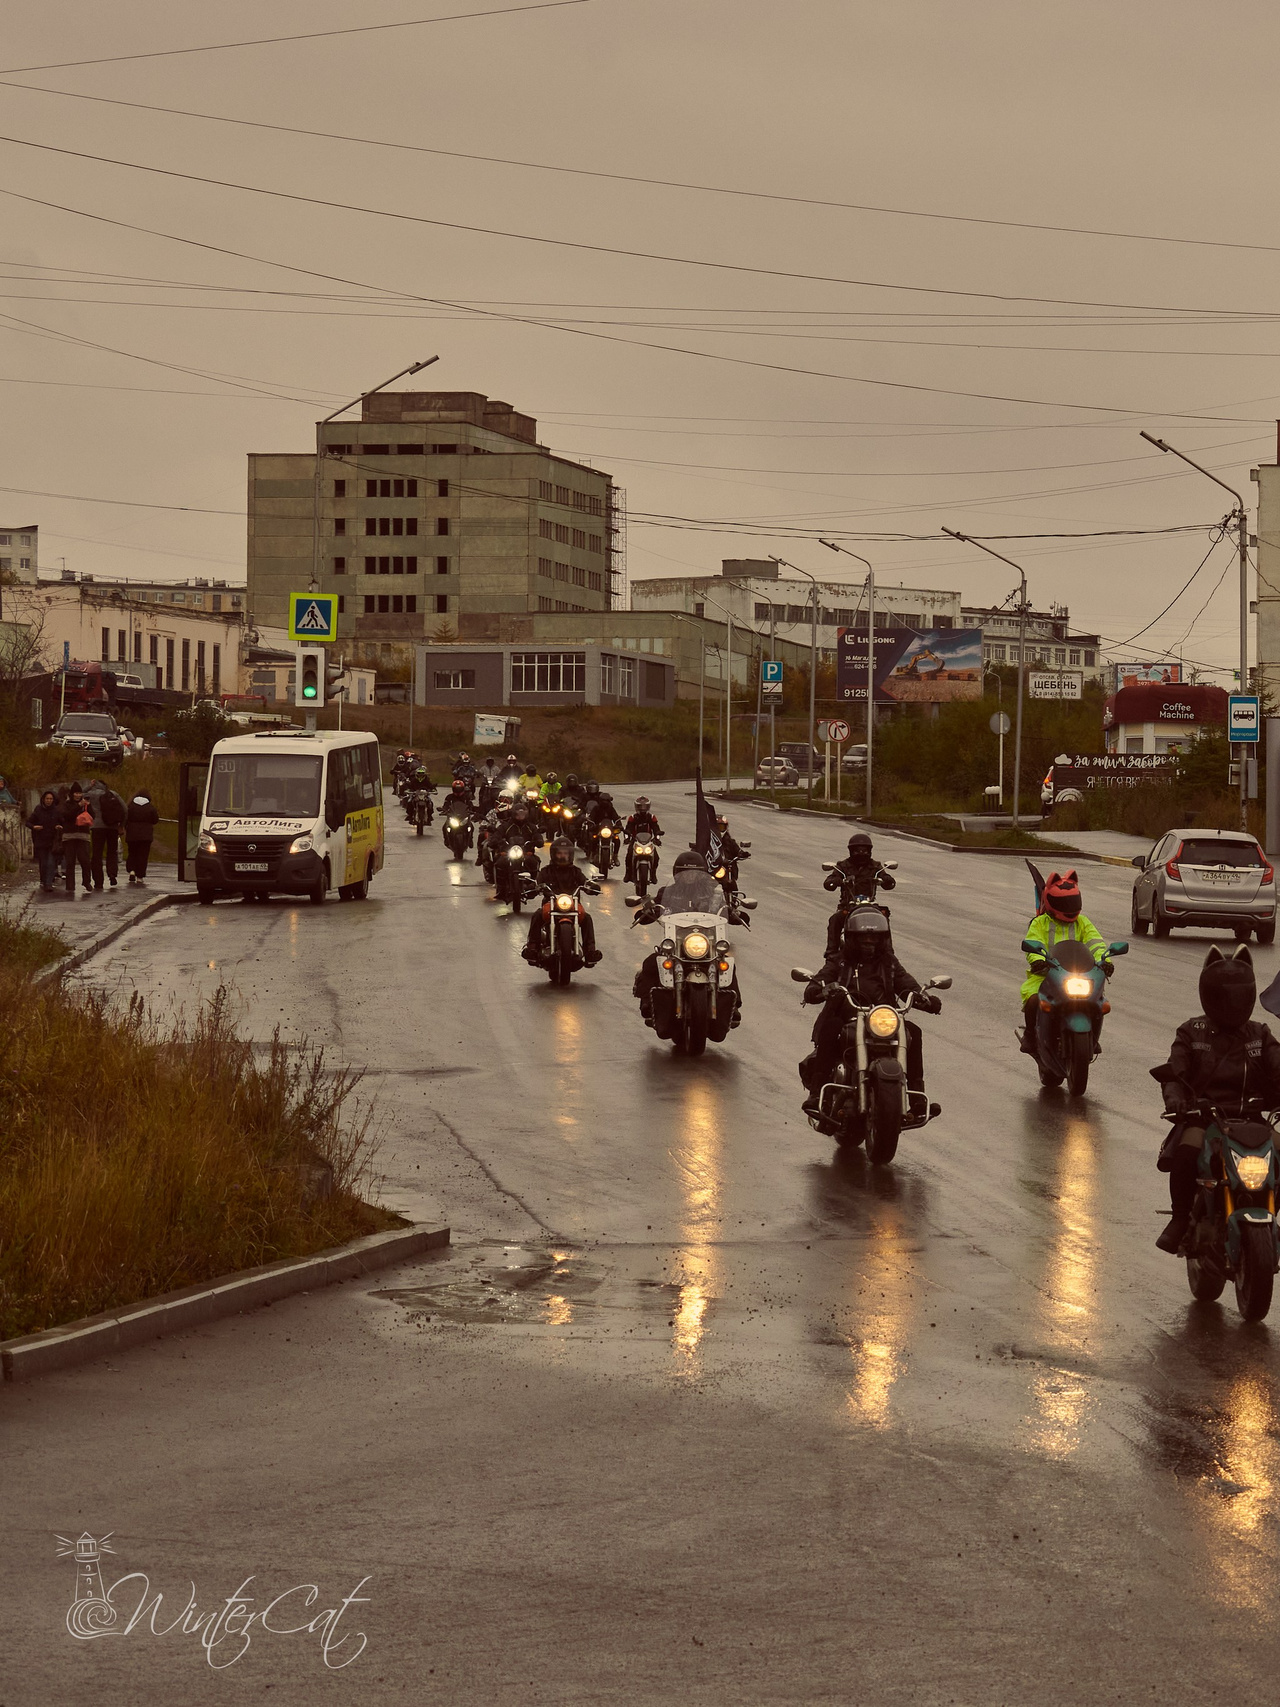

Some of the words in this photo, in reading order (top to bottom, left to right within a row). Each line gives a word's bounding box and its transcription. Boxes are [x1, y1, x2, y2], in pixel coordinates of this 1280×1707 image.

[767, 664, 778, 679] P
[1034, 680, 1077, 690] ЩЕБЕНЬ
[844, 689, 870, 698] 9125
[1162, 702, 1192, 711] Coffee
[1159, 711, 1195, 719] Machine
[218, 760, 235, 772] 50
[233, 819, 303, 829] АвтоЛига
[1193, 1022, 1206, 1030] 49
